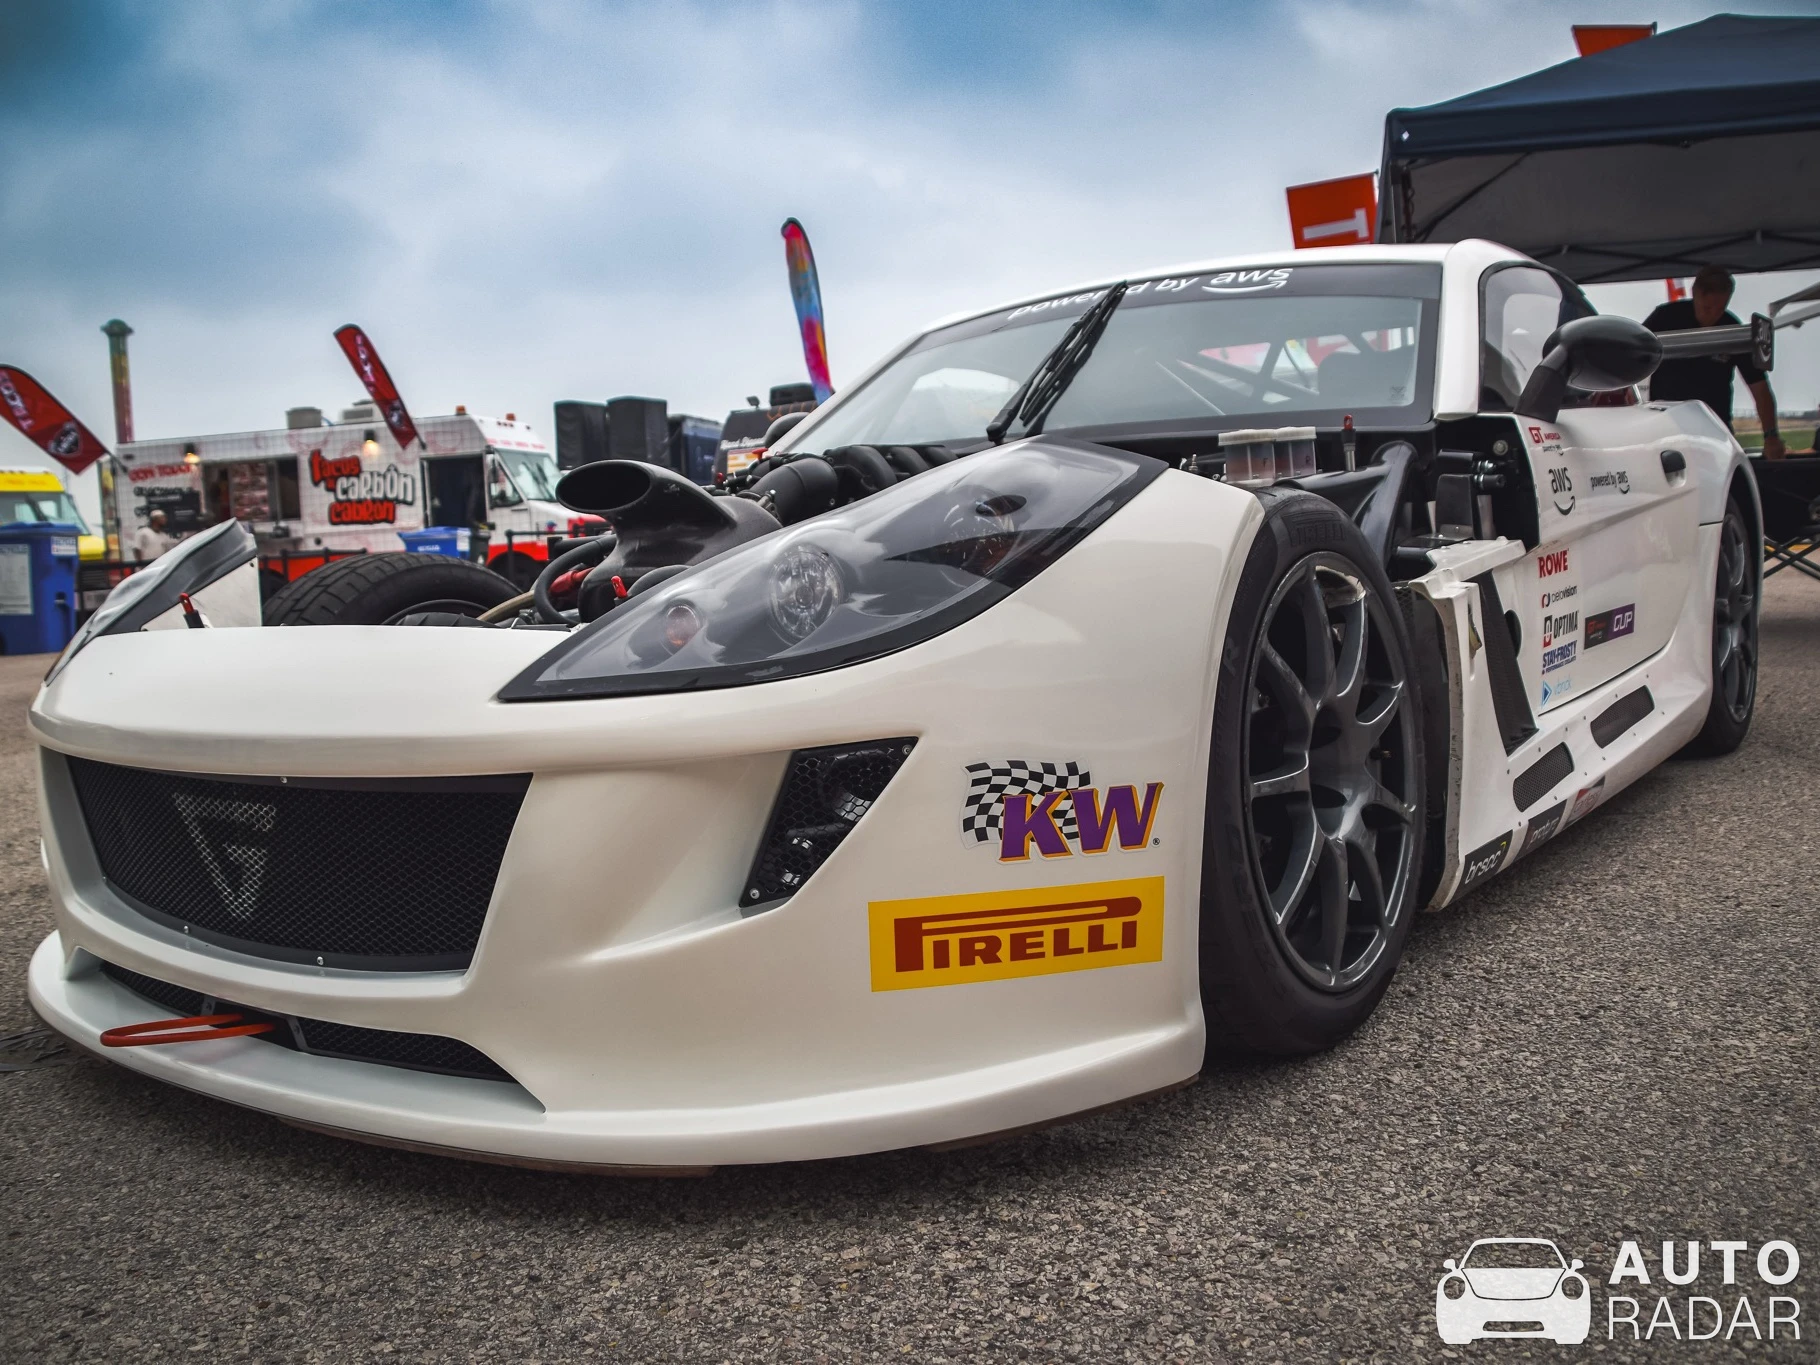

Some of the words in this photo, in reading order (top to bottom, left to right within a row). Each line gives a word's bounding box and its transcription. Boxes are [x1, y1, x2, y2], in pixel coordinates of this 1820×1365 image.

[1154, 276, 1199, 293] by
[1210, 268, 1294, 286] aws
[1548, 466, 1573, 494] aws
[1590, 472, 1611, 491] powered
[1617, 470, 1629, 485] aws
[1281, 510, 1345, 548] PIRELLI
[1538, 549, 1569, 578] ROWE
[1553, 611, 1578, 639] OPTIMA
[1613, 611, 1634, 632] CUP
[1543, 640, 1578, 668] STAY-FROSTY
[999, 782, 1165, 863] KW
[893, 896, 1142, 973] PIRELLI
